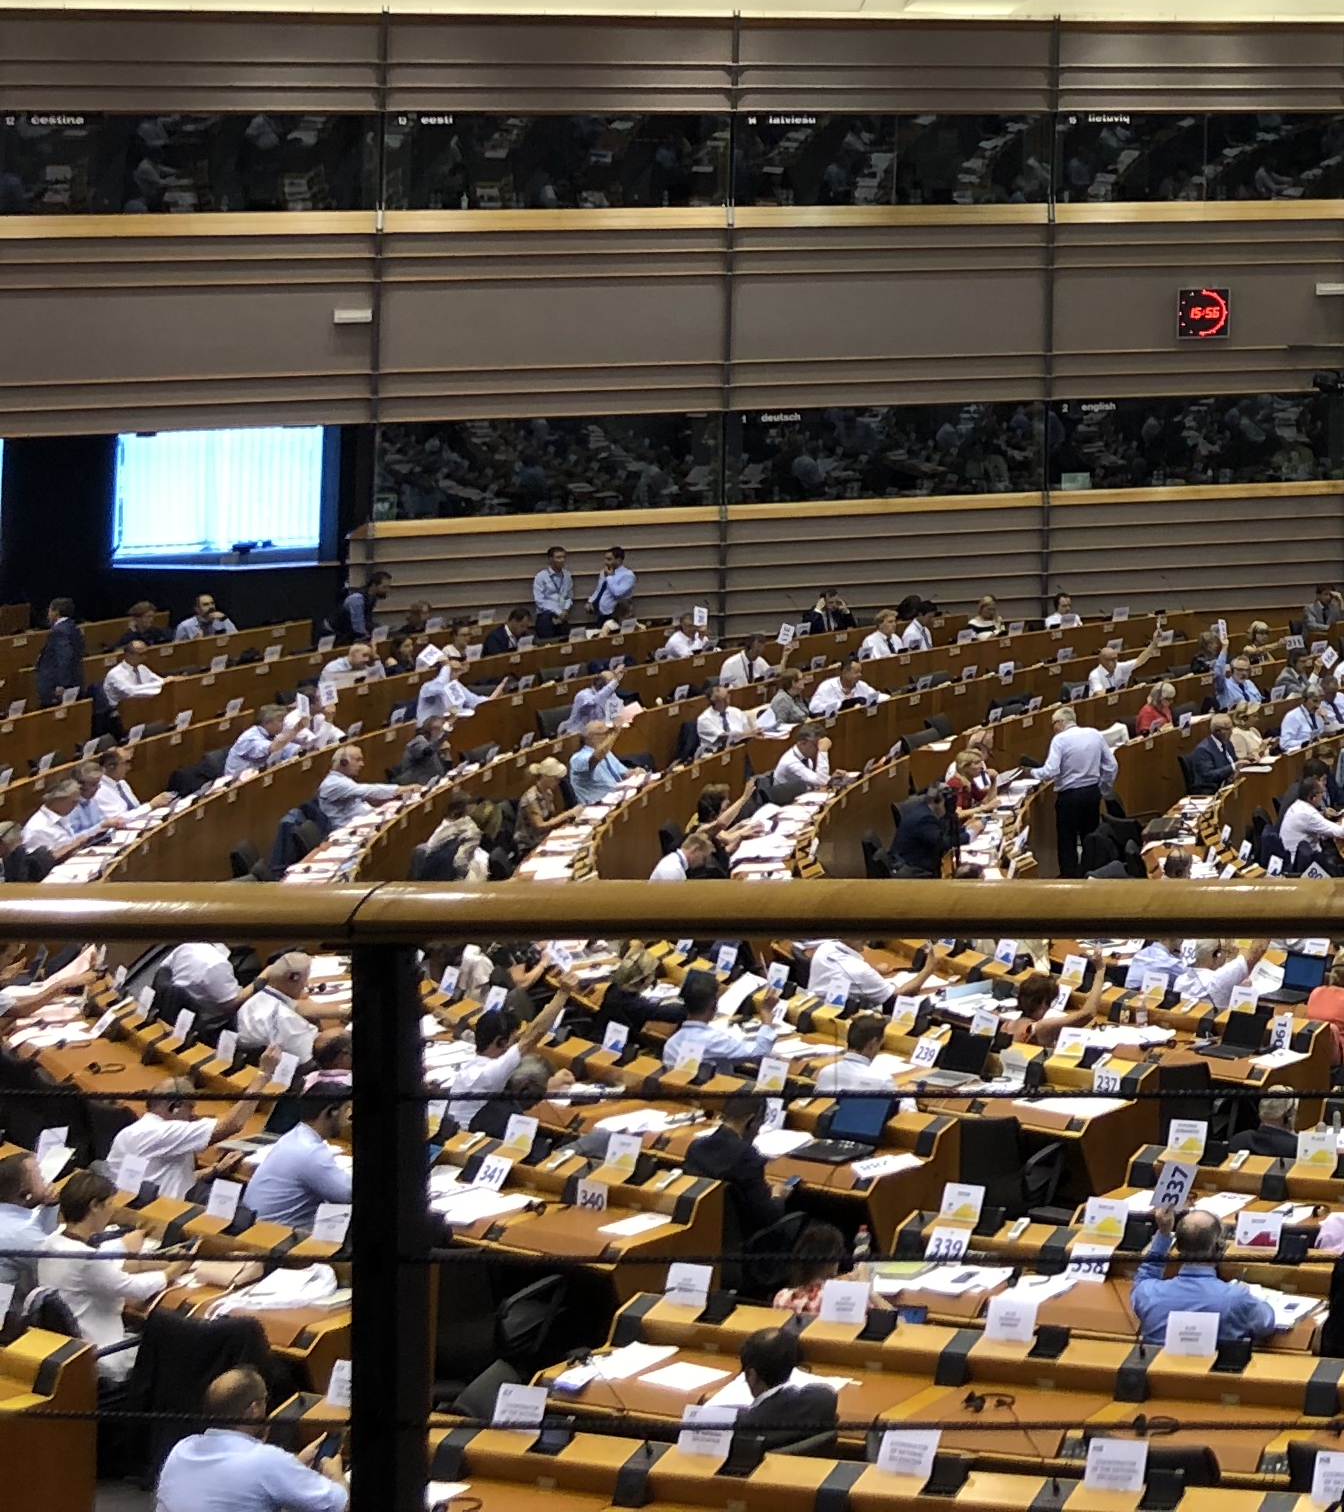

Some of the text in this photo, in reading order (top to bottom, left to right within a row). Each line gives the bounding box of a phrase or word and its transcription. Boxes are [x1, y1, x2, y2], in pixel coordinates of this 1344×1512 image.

[420, 115, 454, 125] eesti
[1189, 306, 1221, 320] 15:56
[1061, 401, 1117, 413] 2 english
[761, 412, 801, 423] deutsch
[1274, 1020, 1288, 1048] 190
[914, 1045, 937, 1062] 239
[1097, 1074, 1118, 1093] 237
[479, 1164, 506, 1184] 341
[1161, 1165, 1189, 1206] 337
[581, 1190, 605, 1211] 340
[931, 1236, 964, 1258] 339
